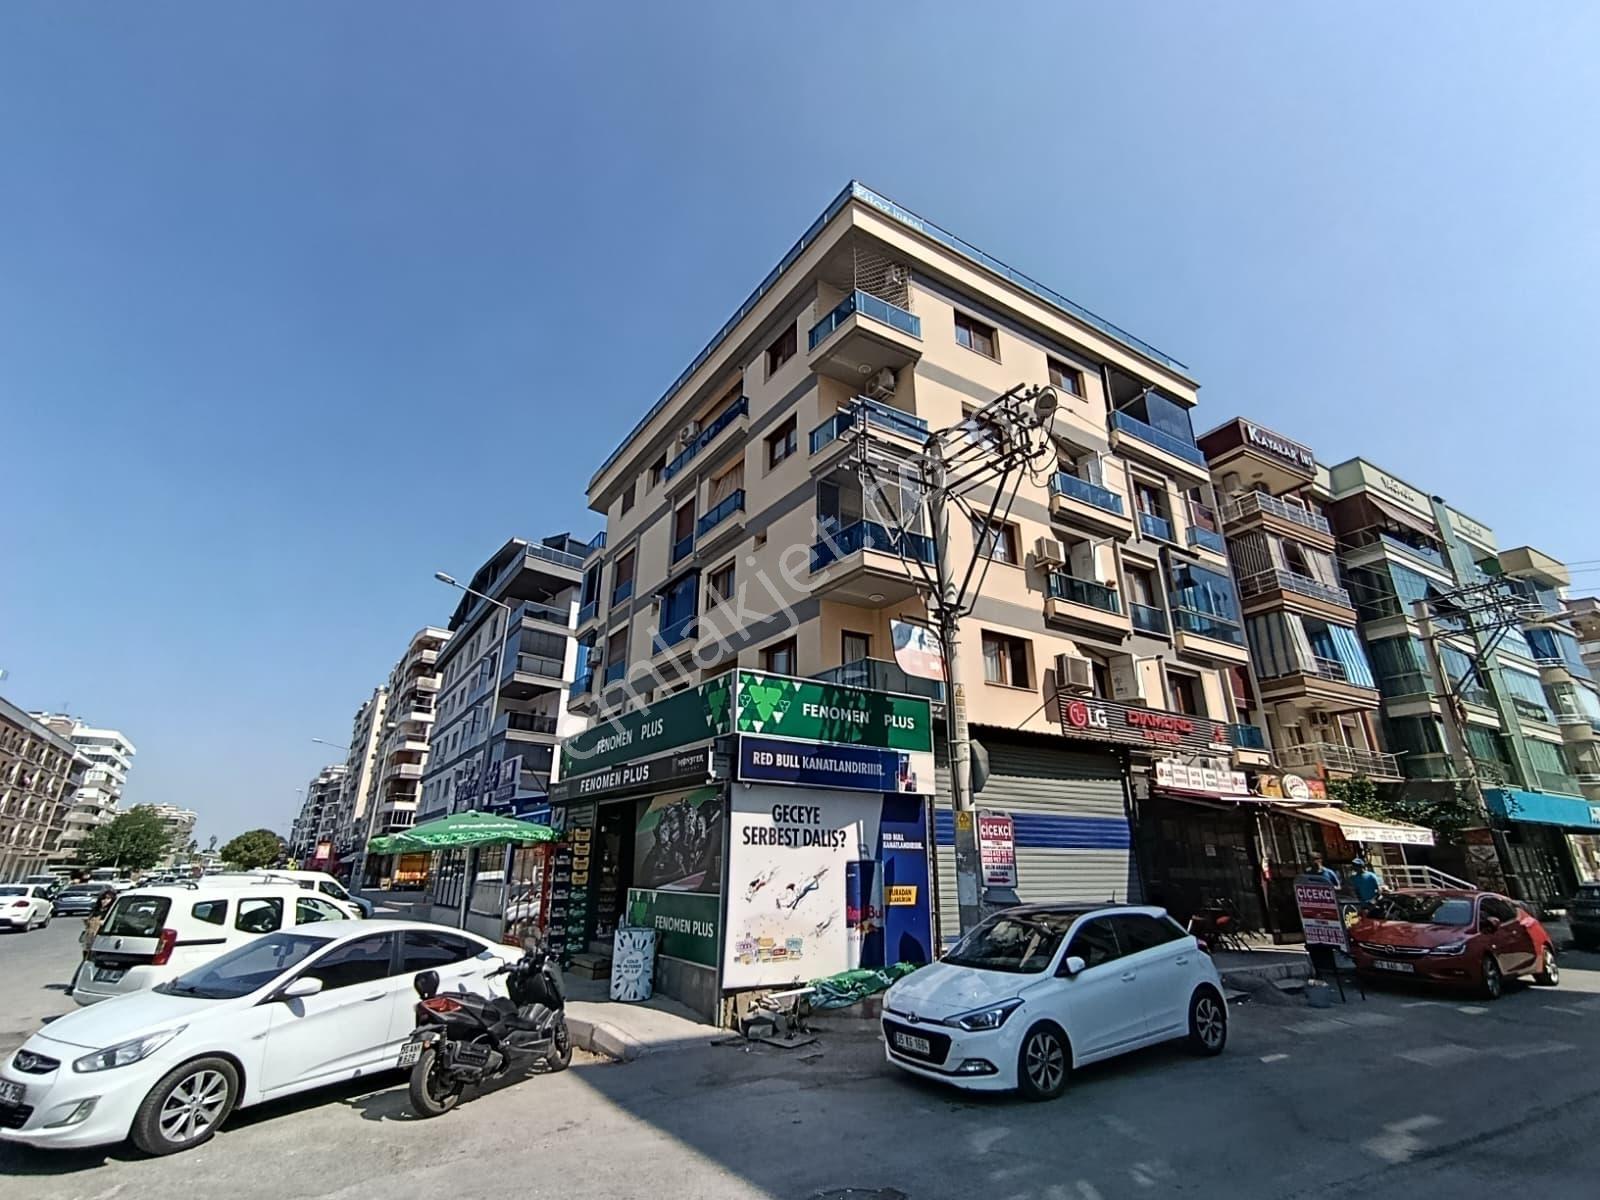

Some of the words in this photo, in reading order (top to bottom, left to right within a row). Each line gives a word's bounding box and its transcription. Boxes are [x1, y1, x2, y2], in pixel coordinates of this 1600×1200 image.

[803, 703, 869, 724] FENOMEN
[884, 714, 914, 729] PLUS
[1087, 707, 1108, 728] LG
[597, 730, 632, 754] FENOMEN
[641, 718, 663, 740] PLUS
[753, 751, 773, 766] RED
[776, 753, 799, 768] BULL
[580, 770, 622, 793] FENOMEN
[623, 765, 649, 785] PLUS
[772, 804, 820, 824] GECEYE
[743, 826, 799, 847] SERBEST
[803, 829, 846, 852] DALIŞ?
[981, 821, 1011, 839] ÇİÇEKÇİ
[655, 915, 690, 934] FENOMEN
[692, 921, 714, 938] PLUS
